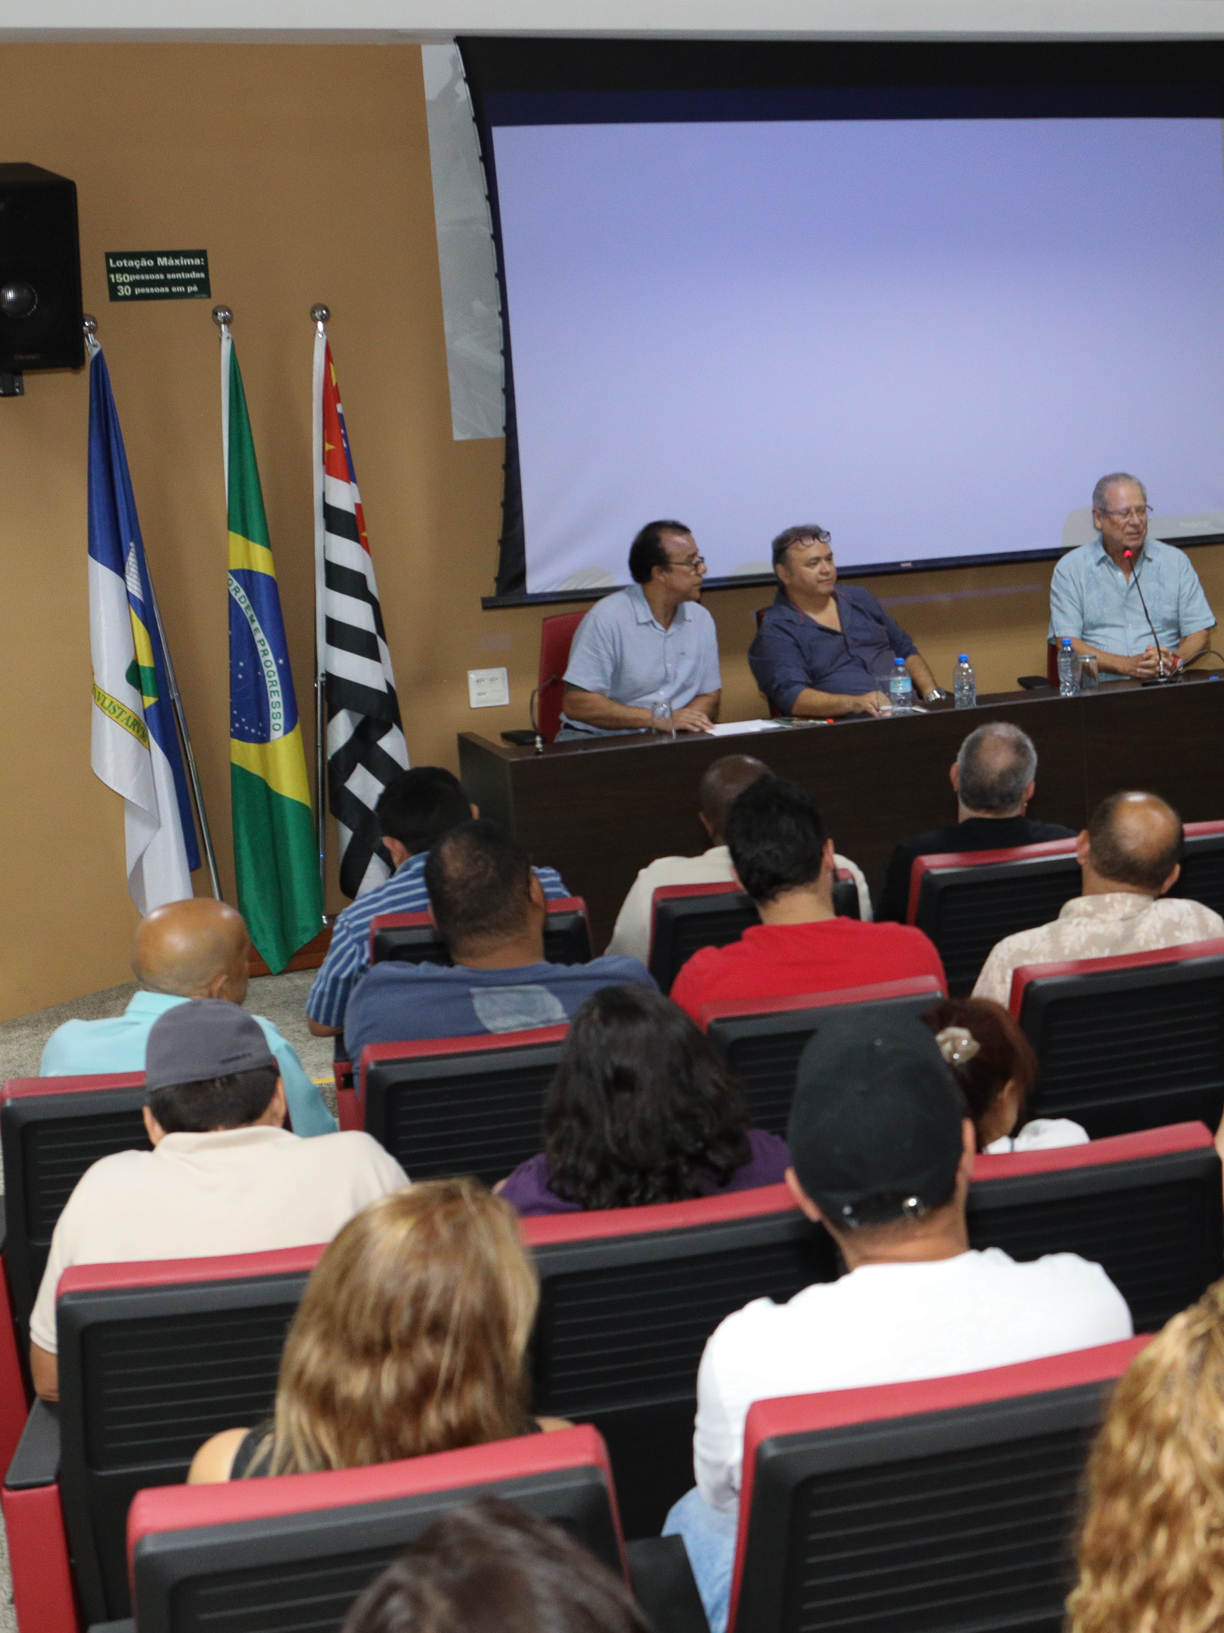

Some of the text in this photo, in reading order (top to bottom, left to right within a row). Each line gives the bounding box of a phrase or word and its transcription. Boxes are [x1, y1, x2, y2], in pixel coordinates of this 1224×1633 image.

[109, 256, 204, 269] Lotação Máxima:
[109, 273, 129, 283] 150
[166, 271, 205, 279] sentadas
[117, 285, 131, 296] 30
[134, 286, 169, 295] pessoas
[187, 285, 198, 293] pé
[228, 577, 282, 732] ORDEM E PROGRESSO
